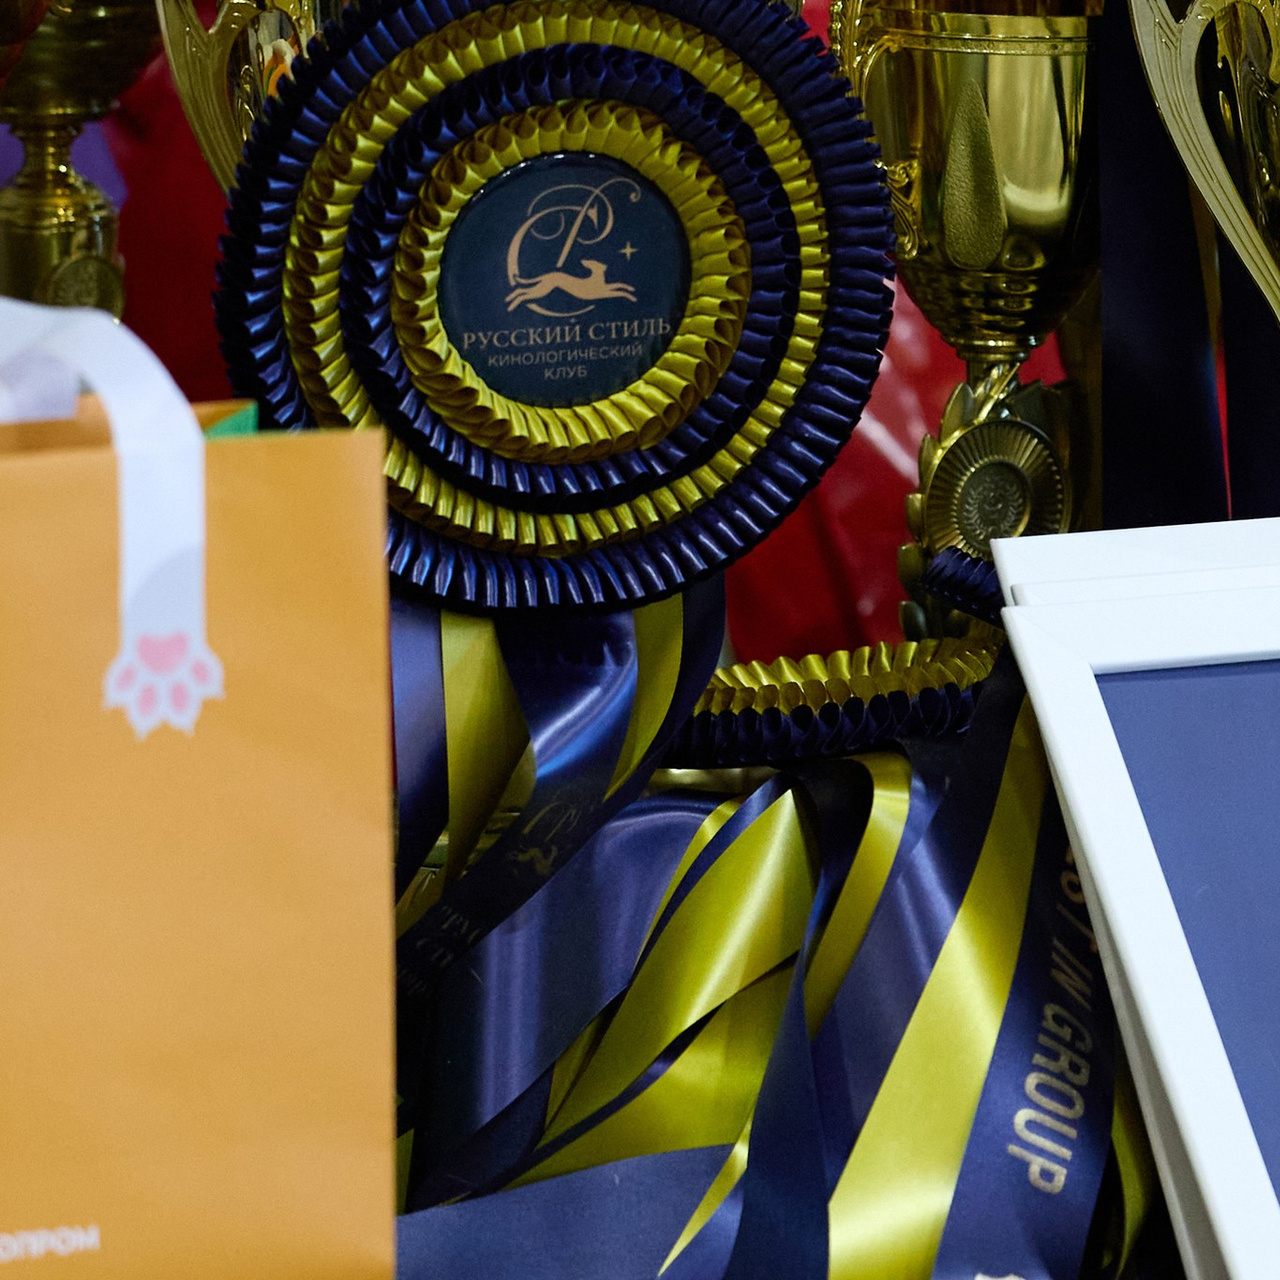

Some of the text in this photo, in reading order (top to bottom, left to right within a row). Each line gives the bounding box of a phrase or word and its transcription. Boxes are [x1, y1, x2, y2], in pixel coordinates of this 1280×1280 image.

[463, 318, 671, 350] РУССКИЙ СТИЛЬ
[488, 342, 643, 368] КИНОЛОГИЧЕСКИЙ
[544, 365, 588, 380] КЛУБ
[1051, 937, 1093, 1012] IN
[1007, 1002, 1093, 1195] GROUP
